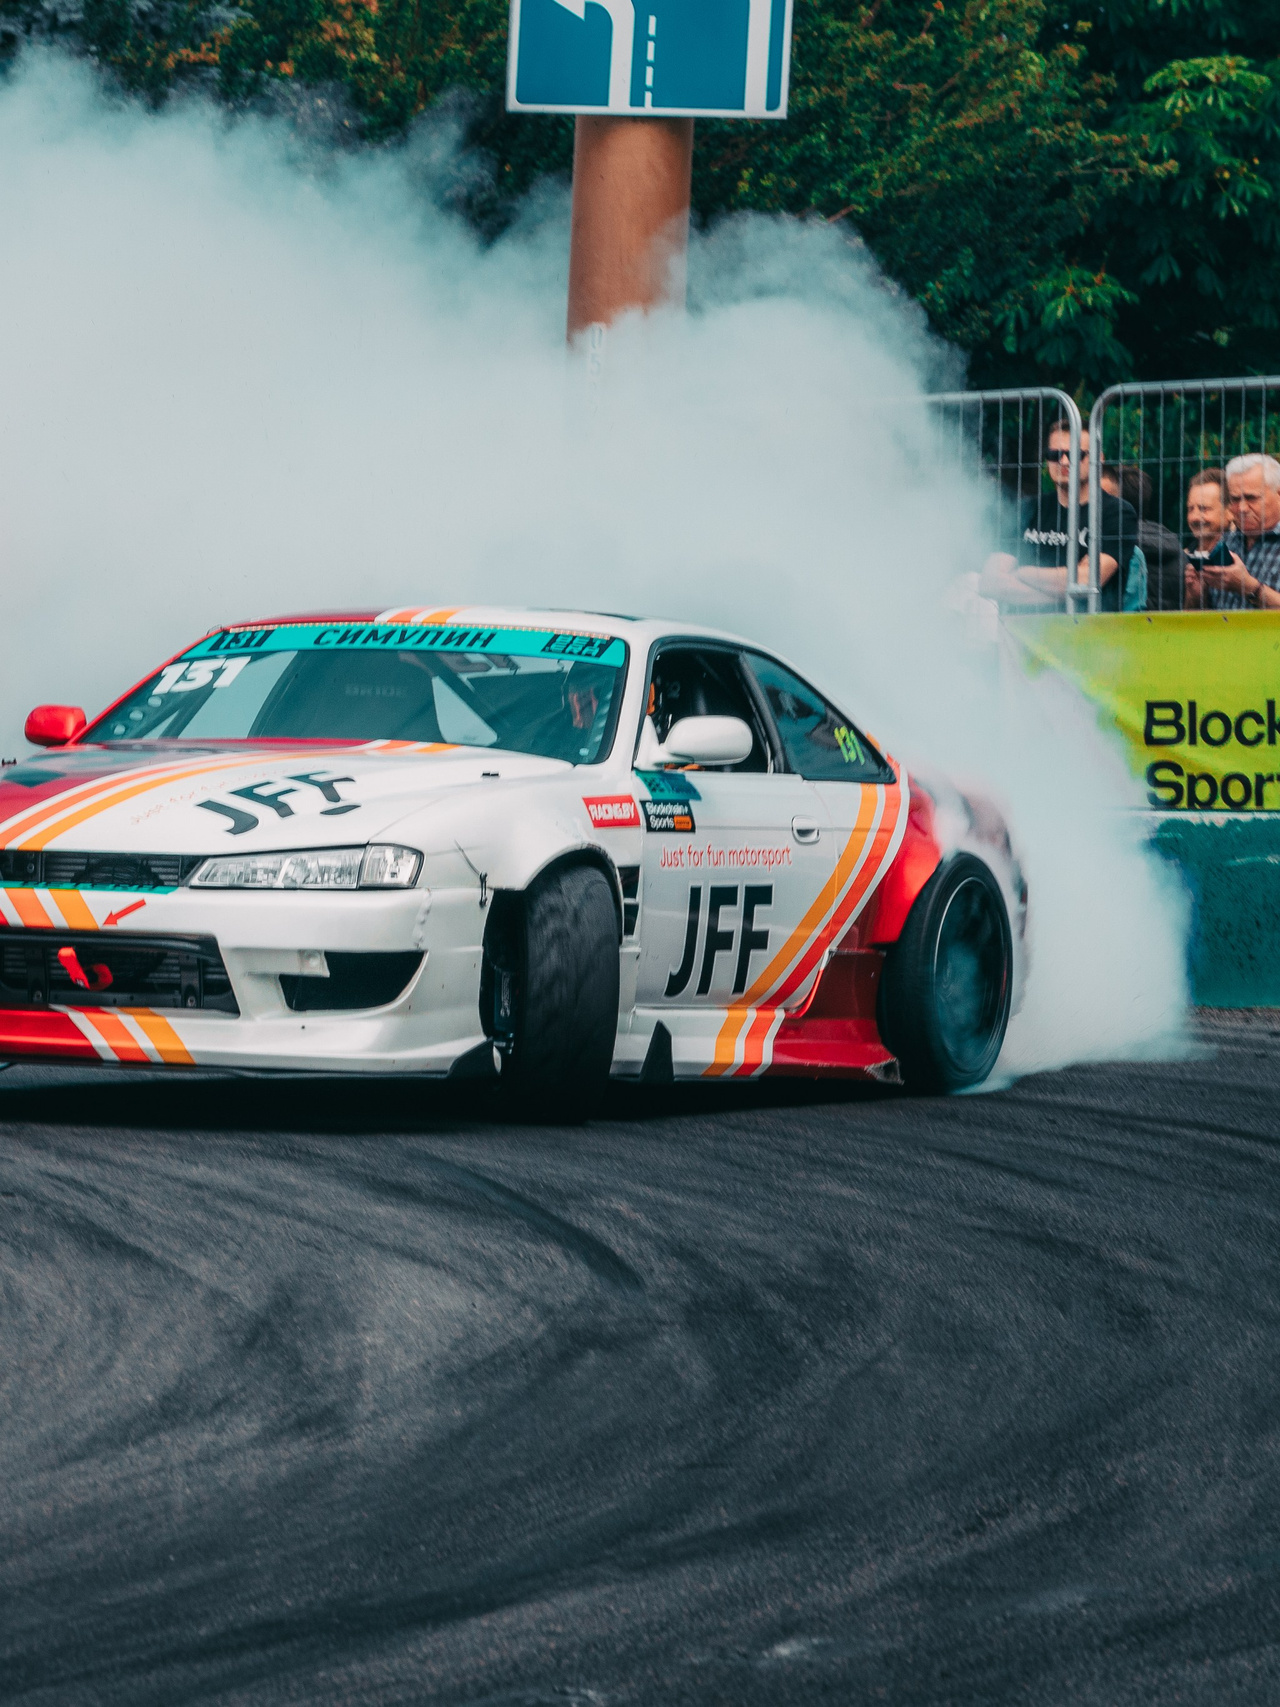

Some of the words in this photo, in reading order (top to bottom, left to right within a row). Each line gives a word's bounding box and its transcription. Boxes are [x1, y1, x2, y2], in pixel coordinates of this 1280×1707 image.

[151, 656, 252, 696] 131
[1146, 760, 1280, 810] Spor
[660, 846, 684, 868] Just
[687, 844, 704, 867] for
[707, 844, 726, 867] fun
[728, 845, 792, 873] motorsport
[663, 884, 774, 998] JFF
